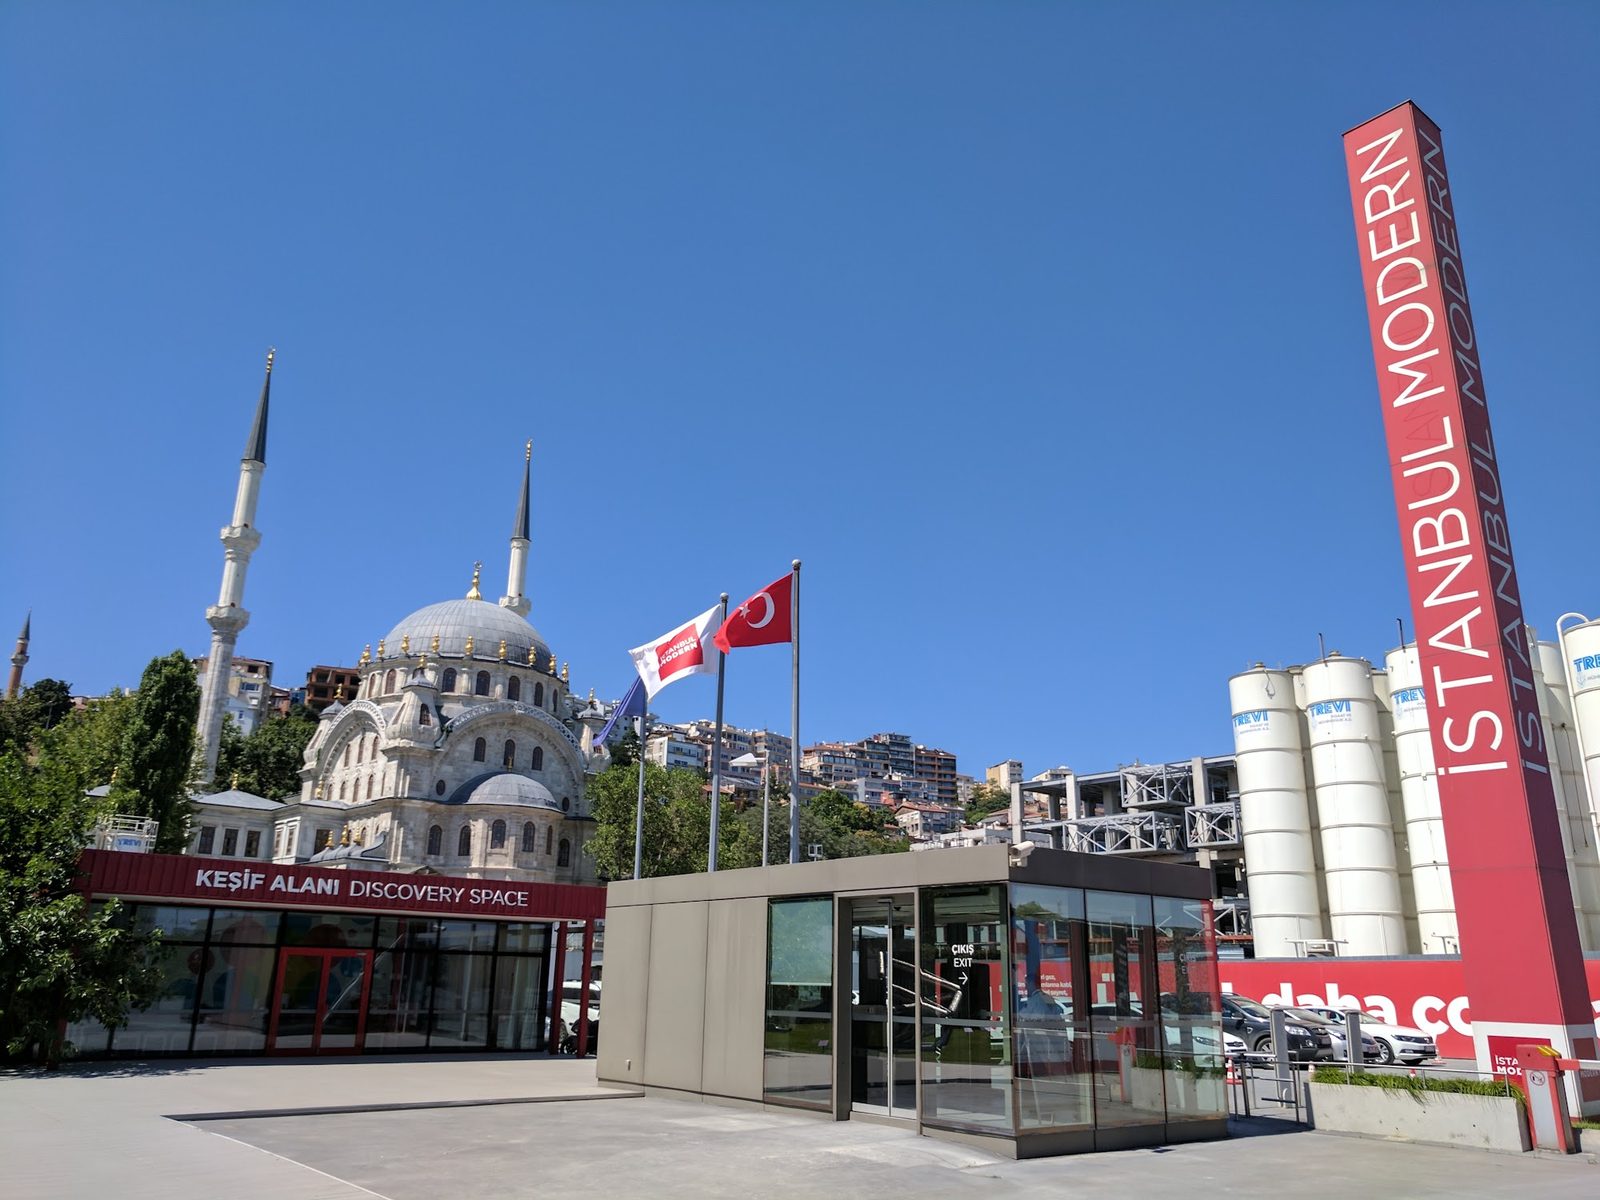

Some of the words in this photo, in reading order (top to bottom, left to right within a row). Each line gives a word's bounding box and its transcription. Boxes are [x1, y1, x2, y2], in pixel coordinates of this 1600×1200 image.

[1356, 127, 1446, 408] MODERN
[1418, 127, 1485, 407] MODERN
[1573, 654, 1600, 672] TRE
[1394, 687, 1425, 704] TREV
[1233, 709, 1268, 727] TREVI
[1310, 701, 1351, 717] TREVI
[196, 868, 265, 892] KEŞİF
[269, 874, 340, 896] ALANI
[350, 880, 465, 903] DISCOVERY
[469, 888, 529, 907] SPACE
[951, 944, 975, 956] ÇIKIŞ
[953, 957, 973, 968] EXIT
[1261, 982, 1398, 1026] dha
